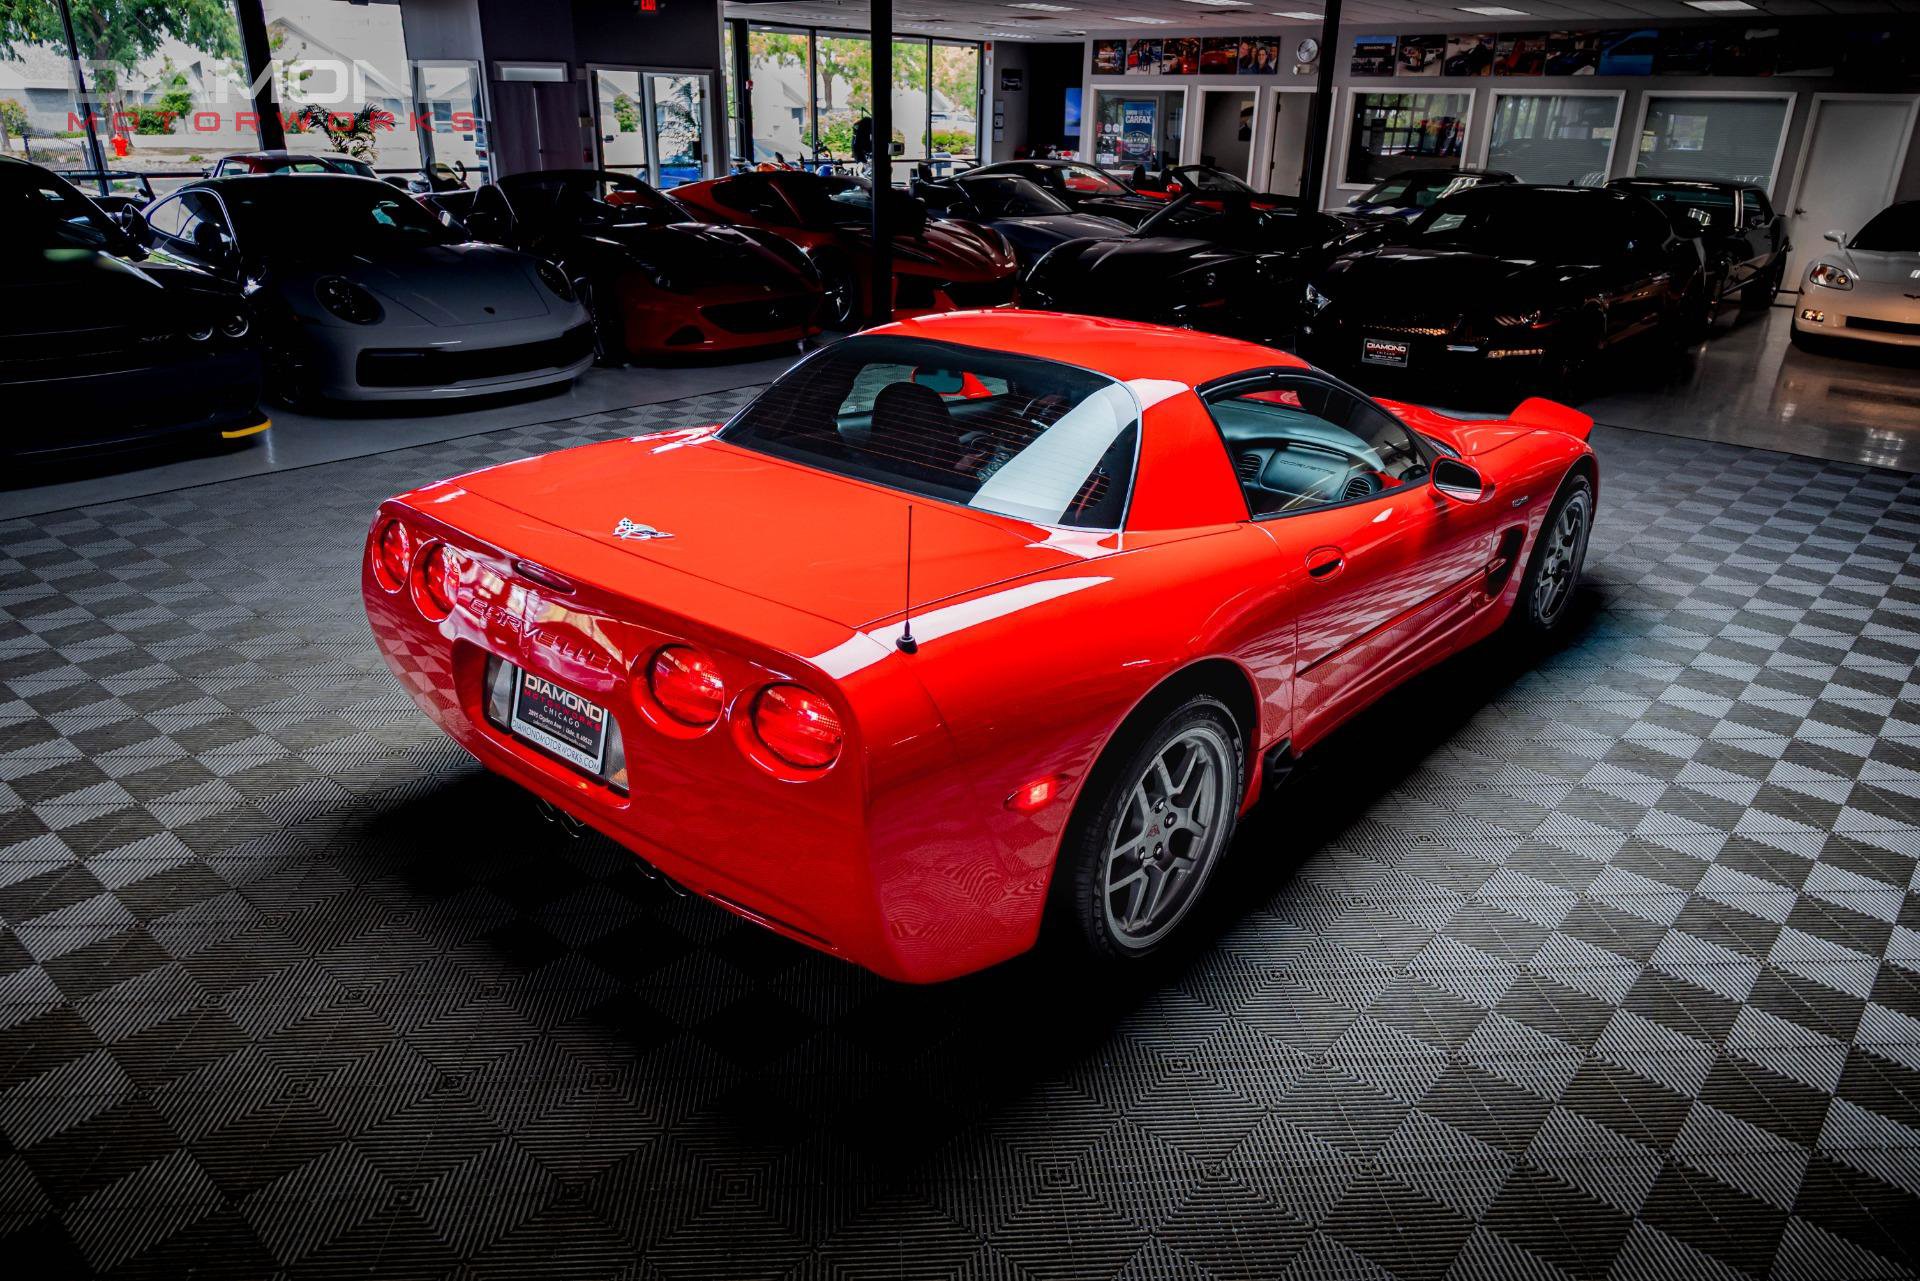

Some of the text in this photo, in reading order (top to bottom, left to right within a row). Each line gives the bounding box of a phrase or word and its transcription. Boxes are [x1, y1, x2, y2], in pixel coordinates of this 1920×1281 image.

[1125, 116, 1151, 124] CARFAX
[1366, 342, 1406, 352] DIAMOND
[525, 673, 603, 723] DIAMOND
[543, 705, 580, 729] CHICAGO
